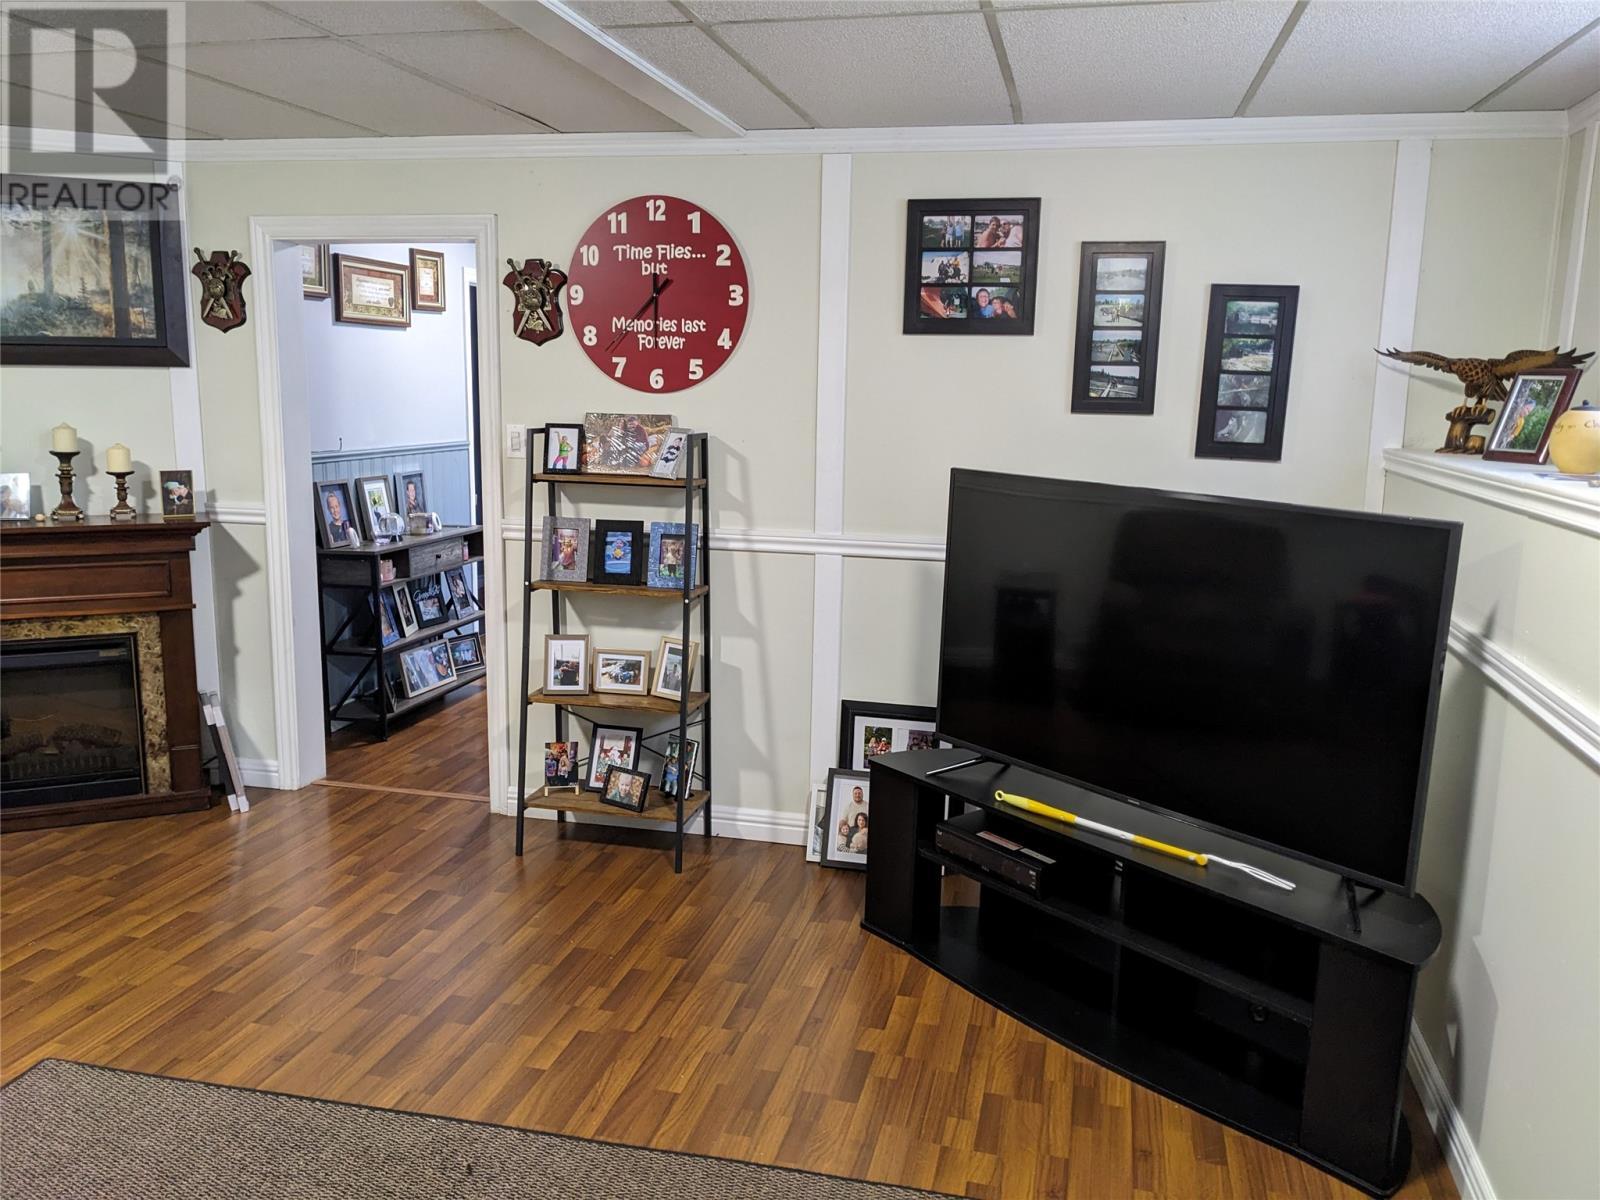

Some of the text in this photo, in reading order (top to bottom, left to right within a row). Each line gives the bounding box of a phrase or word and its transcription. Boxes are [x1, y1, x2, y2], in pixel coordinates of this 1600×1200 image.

[646, 199, 666, 222] 12
[607, 212, 628, 234] 11
[687, 211, 701, 234] 1
[580, 245, 600, 266] 10
[613, 244, 653, 261] Time
[715, 244, 732, 266] 2
[641, 260, 668, 276] but
[569, 284, 584, 306] 9
[728, 284, 744, 306] 3
[612, 316, 707, 333] Memoies last
[583, 325, 598, 347] 8
[717, 328, 732, 350] 4
[611, 356, 627, 378] 7
[688, 358, 704, 380] 5
[649, 368, 664, 390] 6
